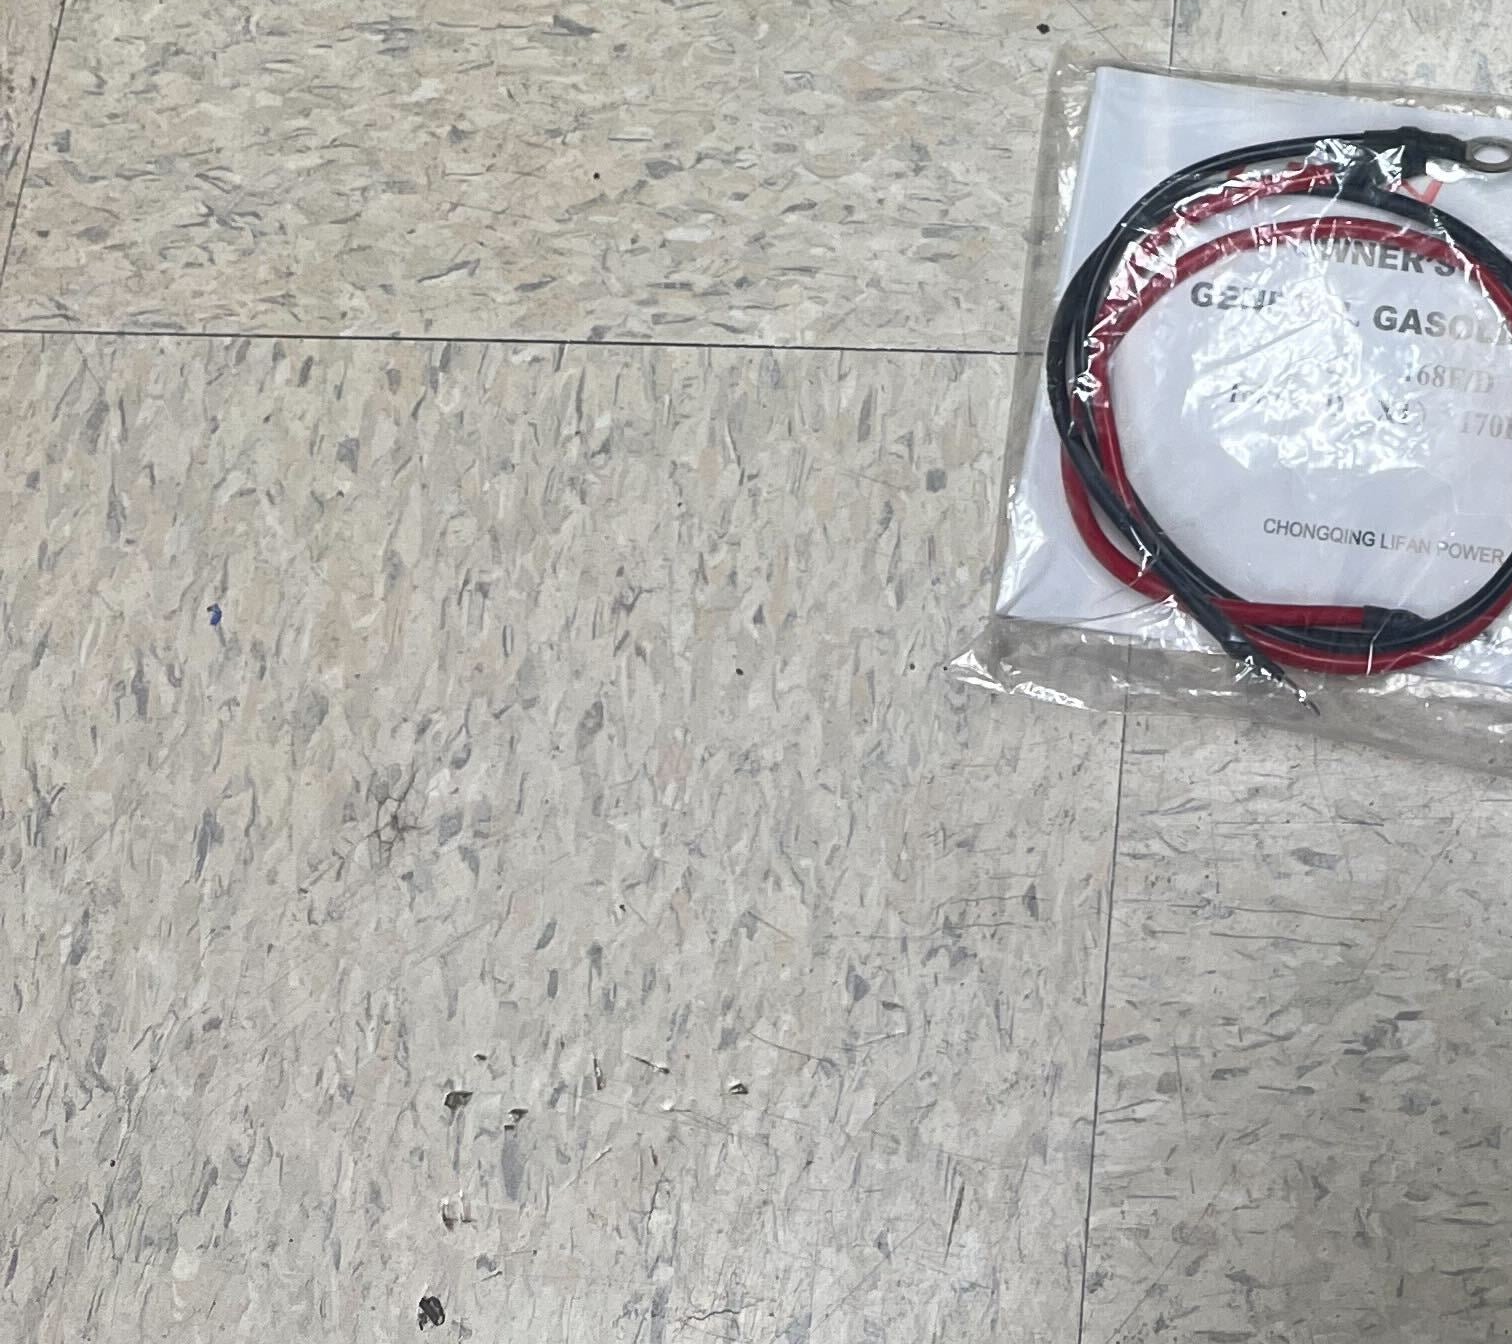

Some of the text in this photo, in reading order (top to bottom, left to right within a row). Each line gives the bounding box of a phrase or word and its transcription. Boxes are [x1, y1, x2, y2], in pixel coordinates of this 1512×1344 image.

[1310, 236, 1456, 277] WNER'S
[1263, 517, 1377, 548] CHONGQING
[1379, 532, 1431, 554] LIFAN
[1436, 540, 1505, 564] POWER
